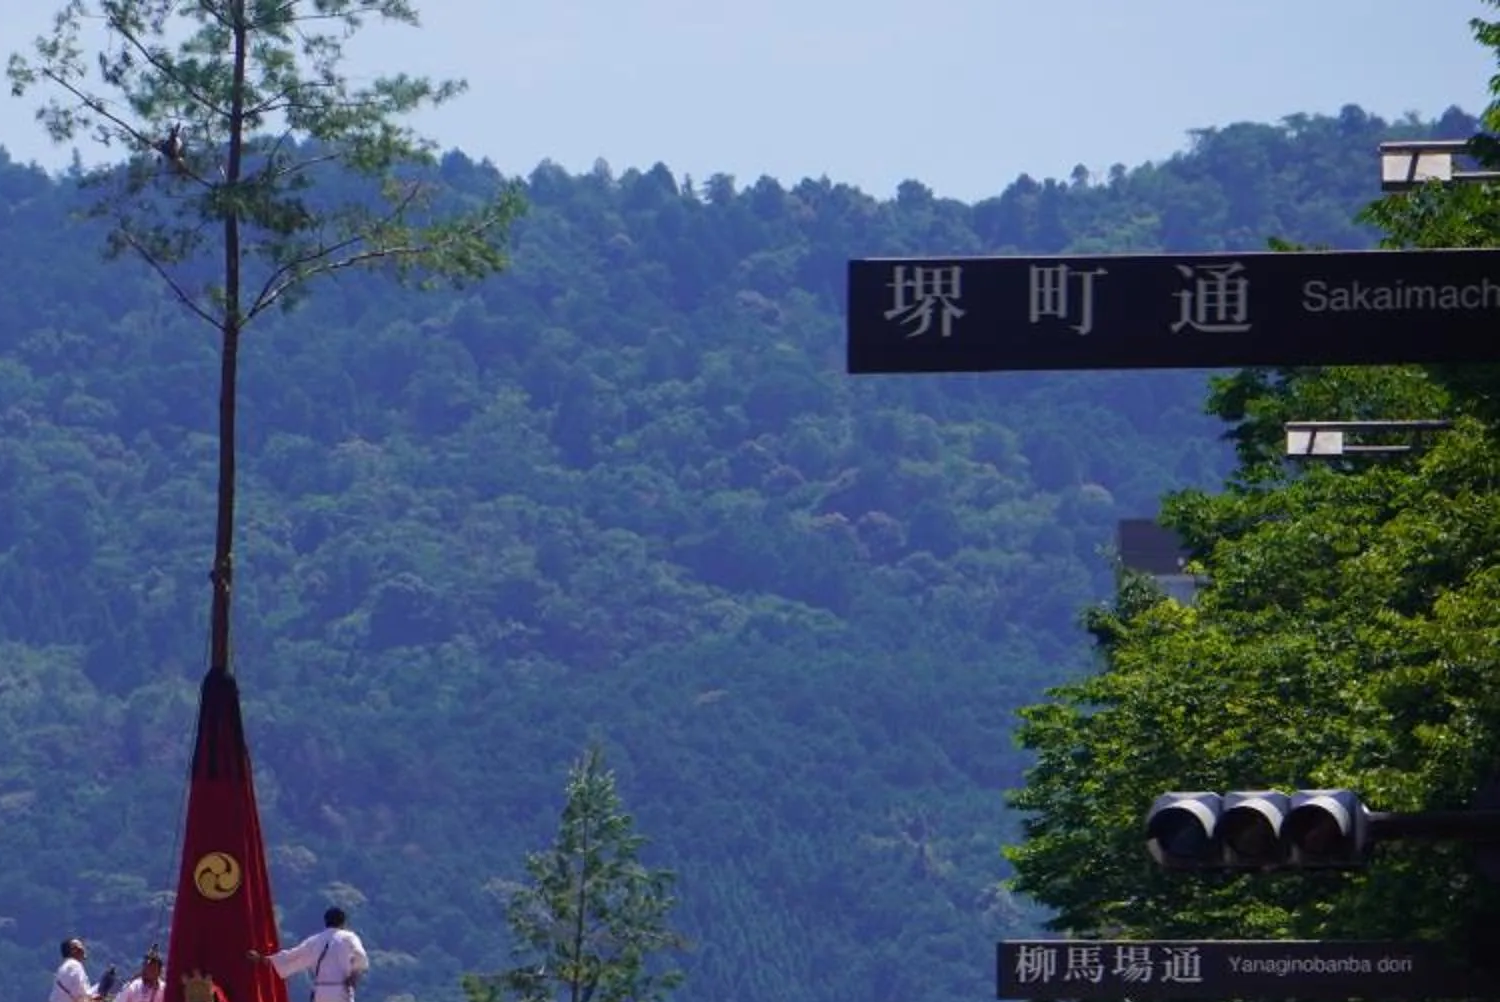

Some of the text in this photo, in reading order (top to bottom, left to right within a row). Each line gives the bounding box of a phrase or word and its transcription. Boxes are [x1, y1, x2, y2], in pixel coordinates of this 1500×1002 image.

[884, 262, 1253, 337] 堺町通
[1015, 945, 1204, 984] 柳馬場通
[1228, 955, 1412, 977] Yanaginobanba dori
